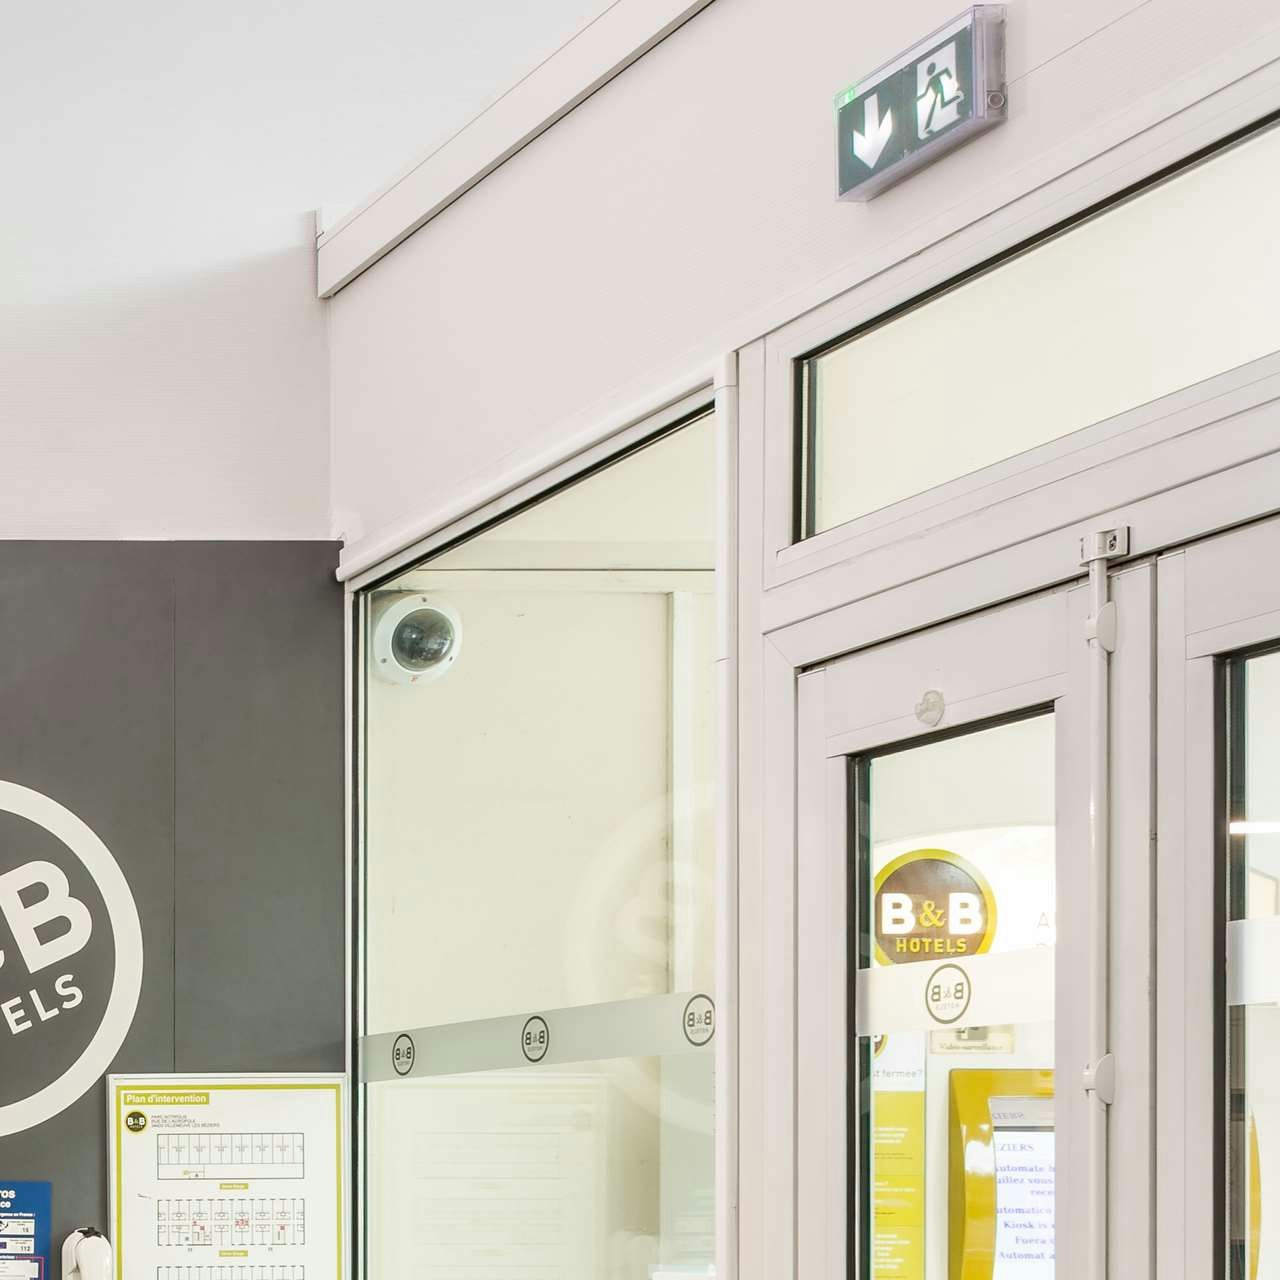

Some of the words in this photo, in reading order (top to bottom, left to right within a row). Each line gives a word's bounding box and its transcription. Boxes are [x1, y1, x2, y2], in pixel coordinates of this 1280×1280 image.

[881, 892, 984, 935] B&B
[895, 937, 967, 953] HOTELS
[126, 1094, 146, 1103] Plan
[147, 1094, 207, 1103] d'intervention
[127, 1117, 145, 1126] B&B
[1004, 1221, 1034, 1229] Kiosk
